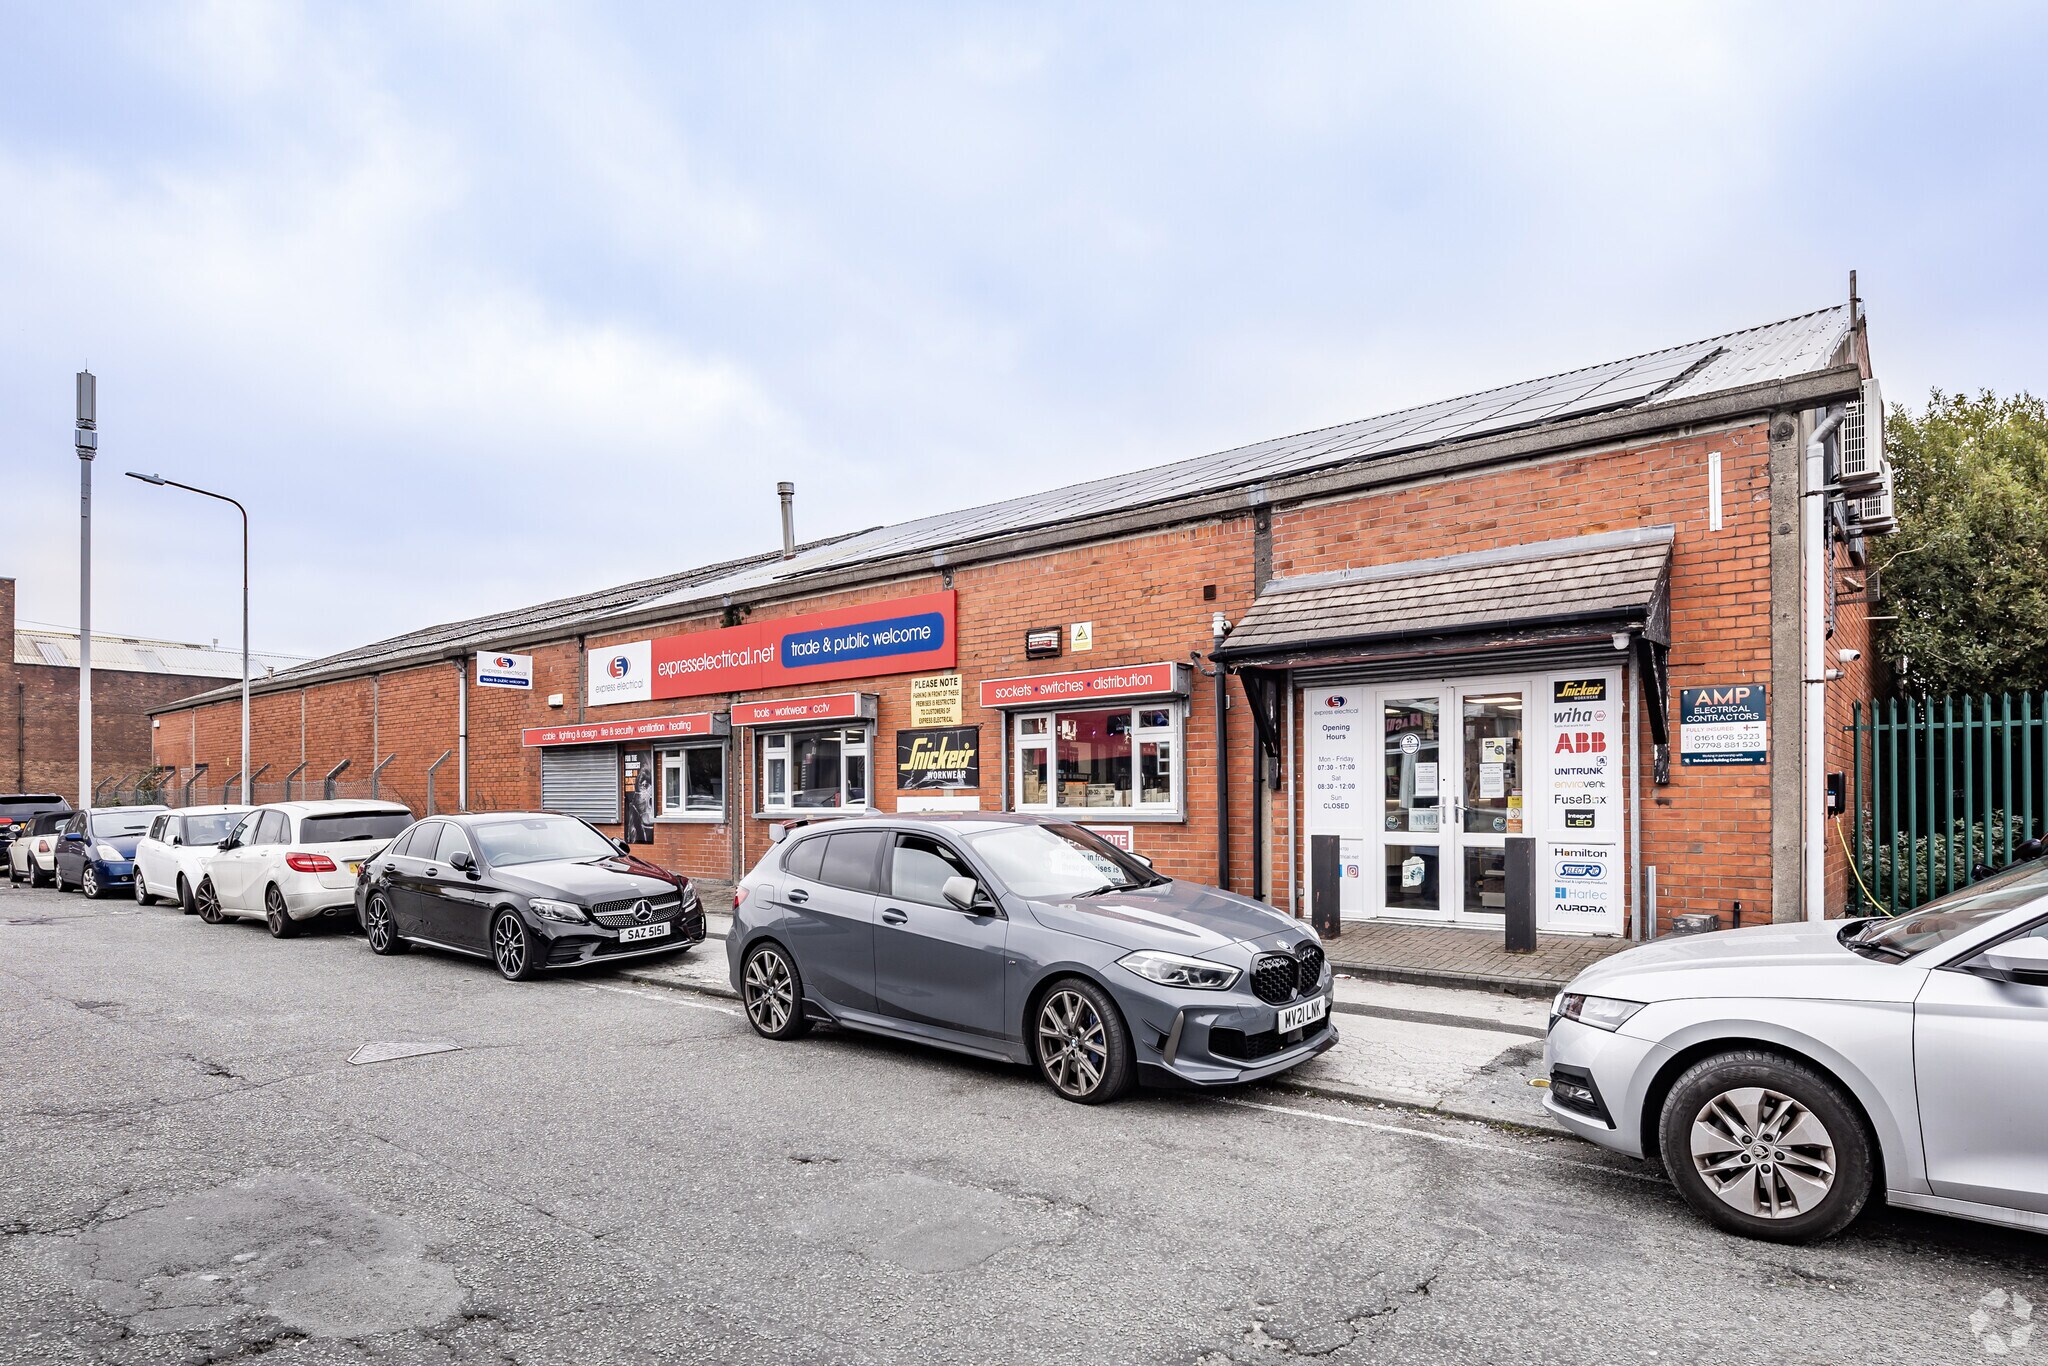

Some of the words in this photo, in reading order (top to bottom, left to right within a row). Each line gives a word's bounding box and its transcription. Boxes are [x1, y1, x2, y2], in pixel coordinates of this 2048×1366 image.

[791, 638, 820, 657] trade
[822, 637, 832, 652] &
[834, 631, 870, 653] public
[872, 624, 931, 645] welcome
[657, 643, 775, 678] expresselectrical.net
[503, 669, 528, 677] electrical
[595, 683, 616, 694] express
[616, 678, 644, 692] electrical
[914, 679, 938, 689] PLEASE
[940, 677, 958, 687] NOTE
[995, 684, 1032, 698] sockets
[1040, 679, 1084, 695] switches
[1093, 673, 1153, 690] distribution
[935, 698, 956, 706] RESTRICTED
[1694, 687, 1751, 706] AMP
[753, 707, 770, 718] tools
[774, 705, 807, 716] workwear
[812, 702, 830, 714] cctv
[1554, 707, 1593, 723] wiha
[1694, 705, 1750, 714] ELECTRICAL
[933, 716, 953, 724] ELECTRICAL
[1686, 713, 1759, 723] CONTRACTORS
[542, 732, 555, 741] cable
[559, 730, 575, 742] lighting
[576, 730, 581, 738] &
[581, 729, 597, 739] design
[600, 727, 609, 736] fire
[609, 727, 614, 736] &
[614, 726, 634, 737] security
[637, 723, 665, 734] ventilation
[668, 720, 692, 733] heating
[1322, 724, 1351, 734] Opening
[1554, 732, 1607, 754] ABB
[1336, 755, 1355, 764] Friday
[926, 770, 967, 781] WORKWEAR
[1554, 767, 1604, 775] UNITRUNK
[1554, 780, 1606, 789] envirovent
[1554, 794, 1607, 804] FuseBox
[1567, 819, 1593, 827] LED
[1554, 848, 1608, 858] Hamilton
[1568, 889, 1607, 900] Harlec
[1555, 904, 1606, 913] AURORA
[628, 929, 646, 940] SAZ
[649, 925, 664, 936] 5151
[1285, 1006, 1305, 1029] MV21
[1306, 1000, 1321, 1020] LNK
